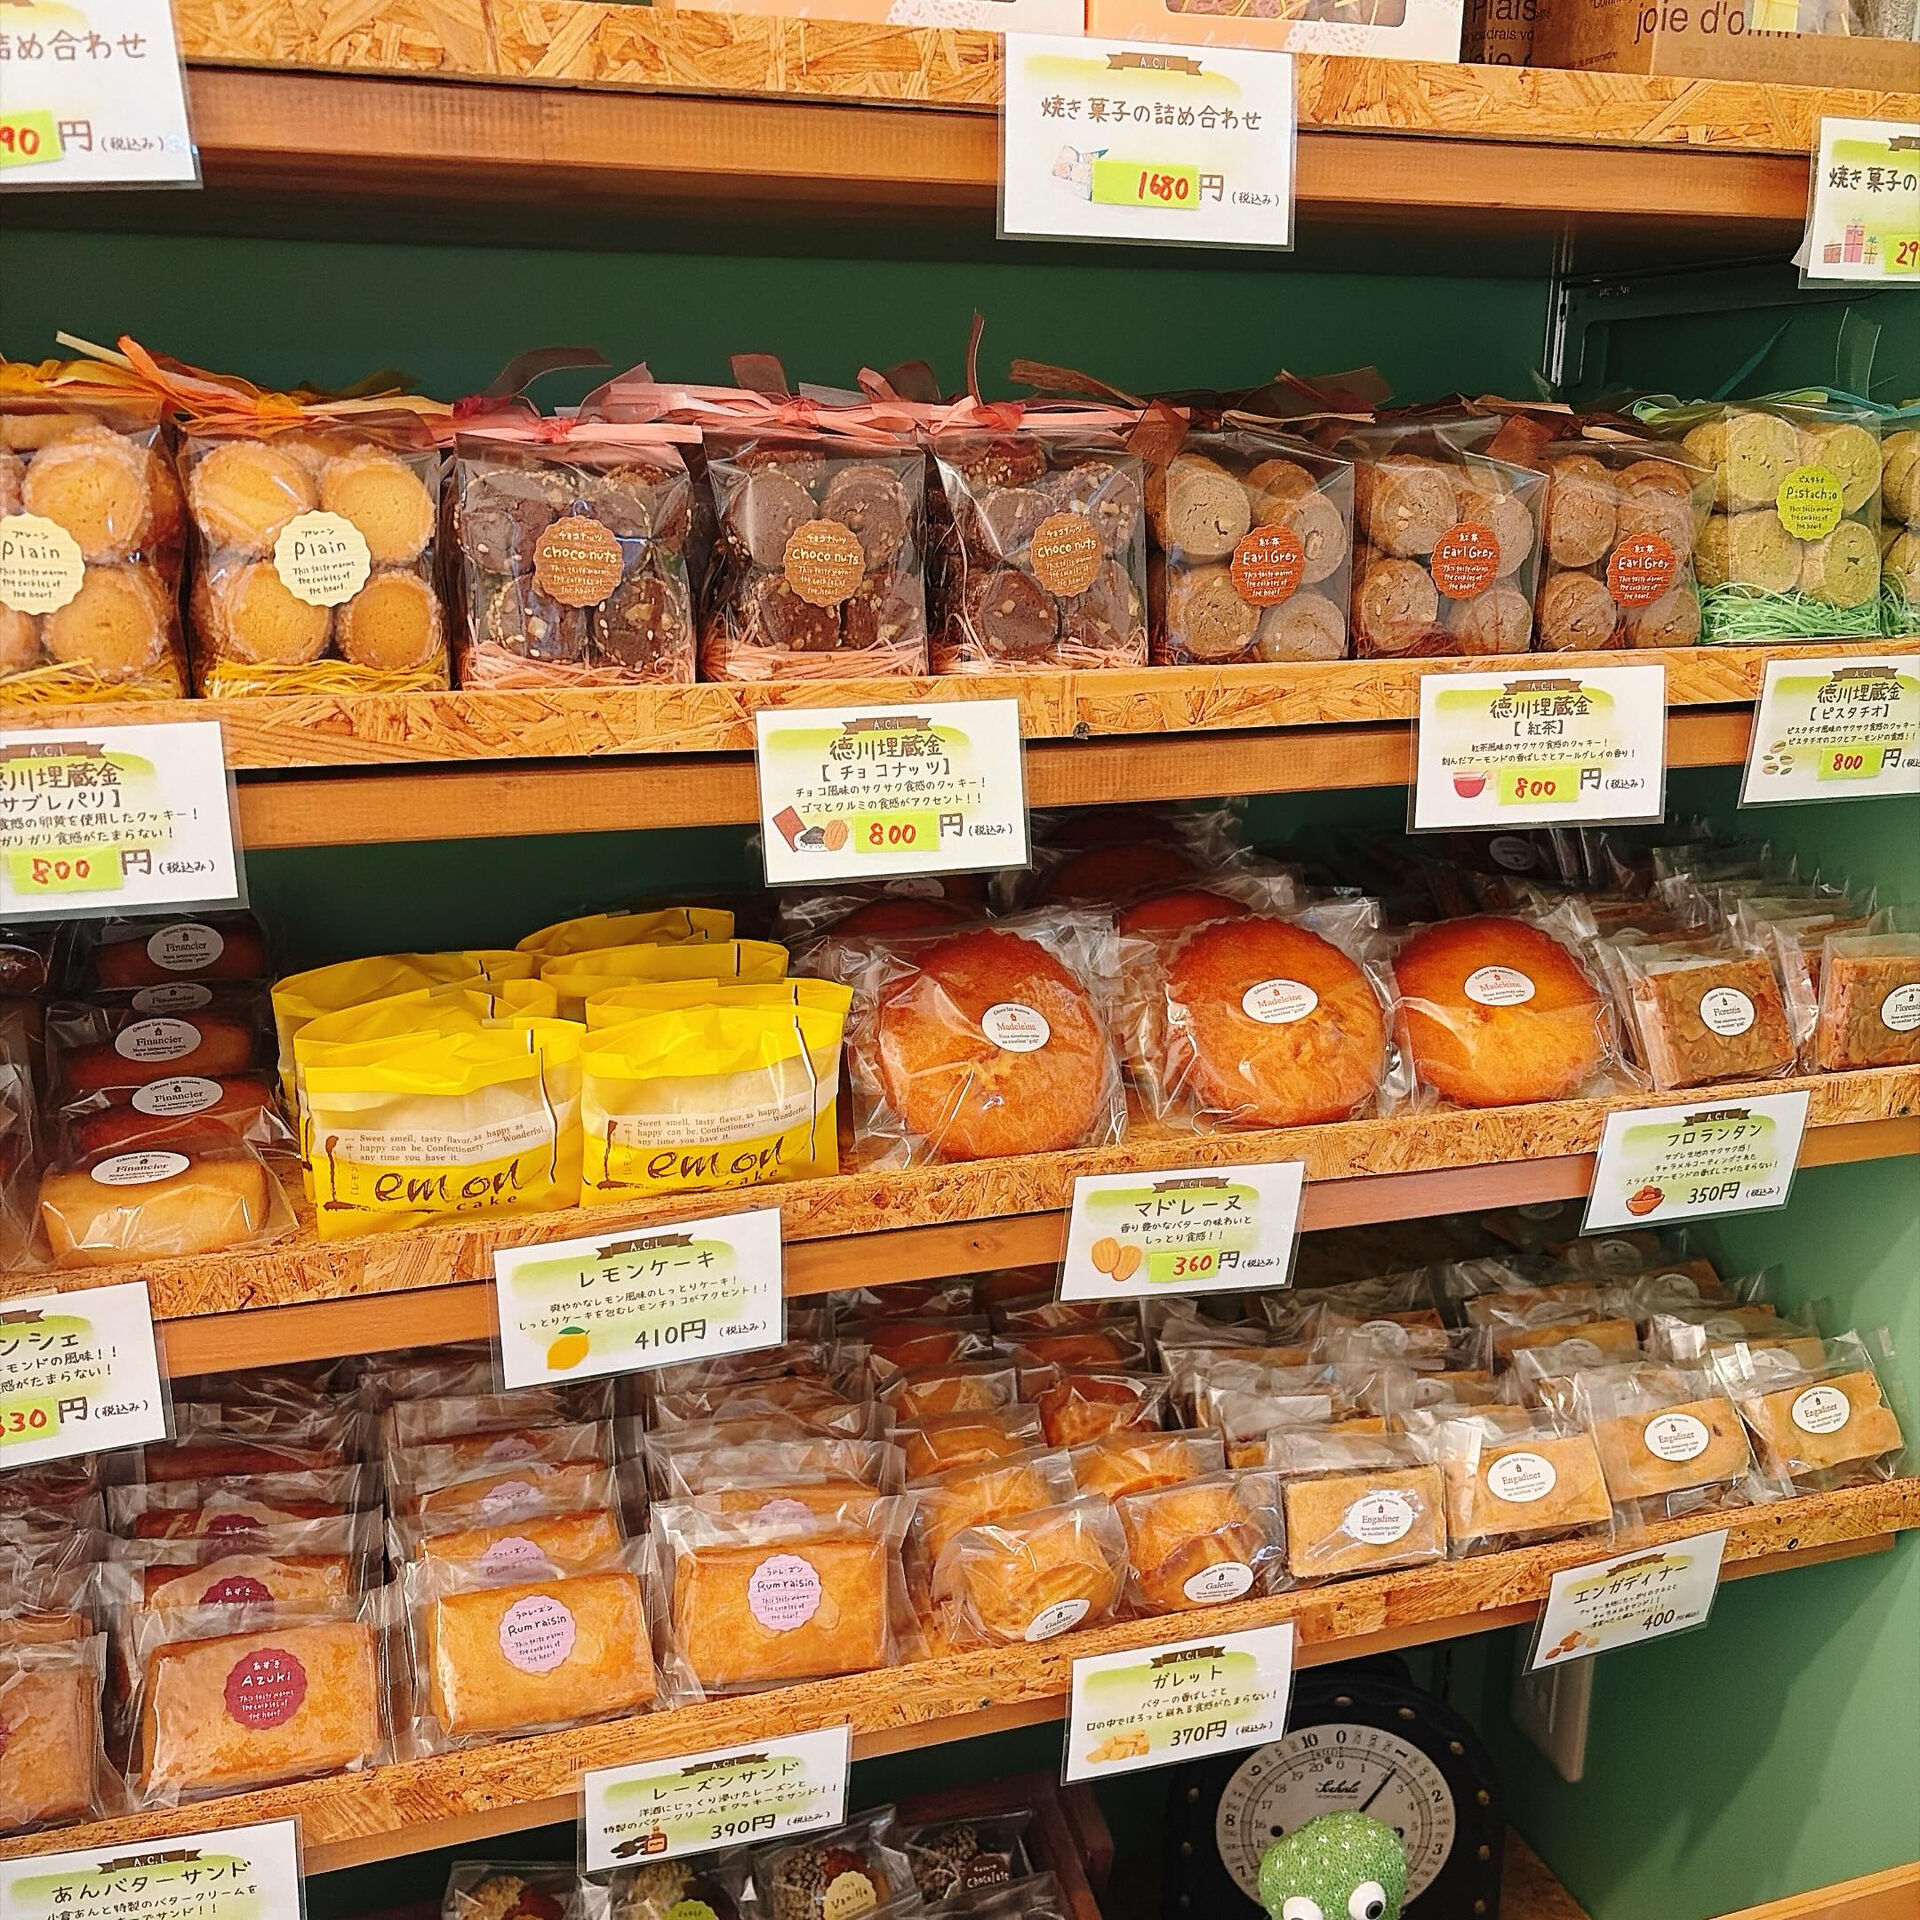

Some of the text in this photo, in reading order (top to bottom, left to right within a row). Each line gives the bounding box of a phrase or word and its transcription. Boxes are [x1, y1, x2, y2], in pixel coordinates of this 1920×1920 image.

[1041, 94, 1262, 131] 焼き菓子の詰め合わせ
[1786, 486, 1837, 500] Pistachio
[3, 541, 60, 560] Plain
[294, 541, 346, 560] Plain
[1242, 549, 1298, 566] Earl Grey
[1443, 546, 1494, 559] Earl Grey
[1618, 557, 1670, 570] Earl Grey
[1817, 681, 1905, 704] 徳川埋蔵金
[1489, 694, 1594, 719] 徳川埋蔵金
[829, 733, 946, 761] 徳川埋蔵金
[0, 761, 124, 793] 川埋蔵金
[638, 1119, 661, 1128] Sweet
[695, 1118, 714, 1127] tasty
[360, 1134, 385, 1143] Sweet
[421, 1135, 441, 1144] tasty
[486, 1126, 511, 1139] happy
[637, 1128, 662, 1138] happy
[1667, 1123, 1764, 1148] フロランタン
[360, 1143, 386, 1153] happy
[360, 1155, 375, 1163] any
[405, 1155, 420, 1163] you
[425, 1154, 446, 1162] have
[1687, 1180, 1741, 1205] 350円
[456, 1194, 518, 1211] cake
[1134, 1194, 1243, 1219] マドレーヌ
[1120, 1214, 1253, 1234] 香り豊かなバターの味わいと
[579, 1250, 714, 1289] レモンケーキ
[634, 1318, 707, 1350] 410円
[0, 1364, 112, 1394] 感がたまらない！
[1362, 1514, 1400, 1526] Engadiner
[757, 1579, 814, 1592] Rum raisin
[1573, 1565, 1689, 1605] エンガディナー
[507, 1615, 567, 1637] Rum raisin
[241, 1672, 292, 1688] Azuki
[1153, 1665, 1223, 1690] ガレット
[1141, 1686, 1228, 1709] バターの香ばしさと
[1170, 1719, 1228, 1747] 370円
[1302, 1733, 1319, 1749] 10
[1336, 1730, 1347, 1744] 0
[653, 1762, 800, 1800] レーズンサンド
[1432, 1789, 1444, 1803] 2
[711, 1813, 776, 1840] 390円
[1224, 1813, 1236, 1826] 8
[1432, 1842, 1443, 1855] 3
[52, 1859, 253, 1905] あんバターサンド
